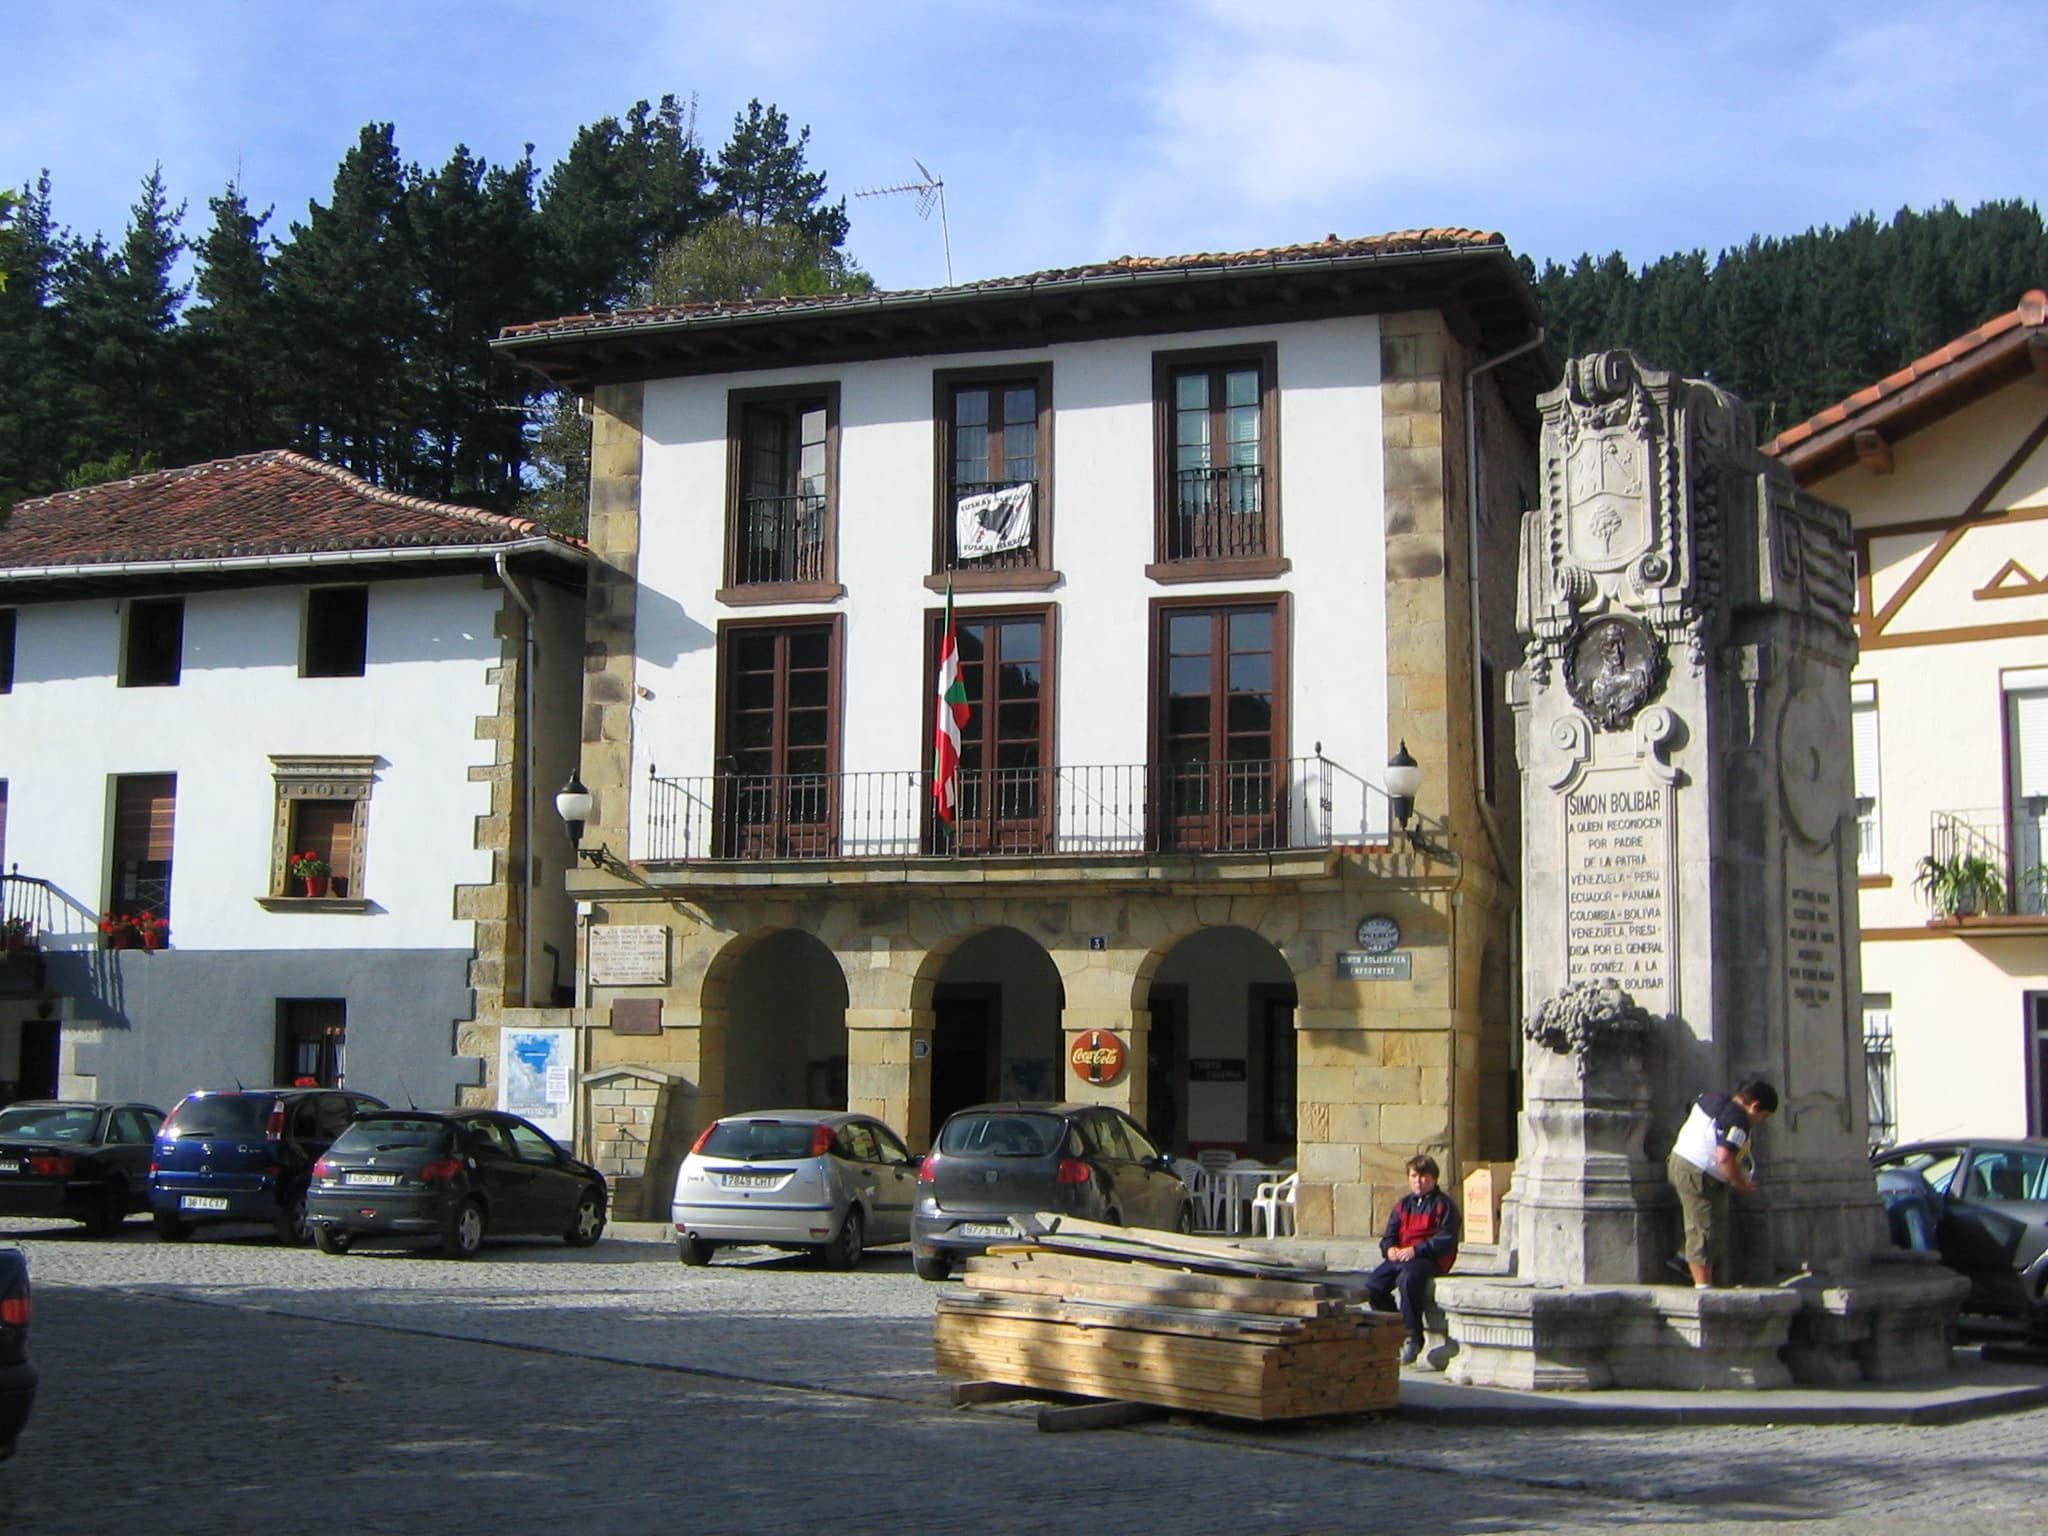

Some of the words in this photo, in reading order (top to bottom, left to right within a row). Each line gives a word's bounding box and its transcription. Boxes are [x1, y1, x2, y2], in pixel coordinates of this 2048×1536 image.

[1569, 793, 1606, 816] SIMON
[1611, 790, 1661, 814] BOLIBAR
[1577, 821, 1603, 832] QUIEN
[1607, 818, 1662, 831] RECONOCEN
[1588, 838, 1607, 849] POR
[1614, 836, 1643, 848] PADRE
[1584, 857, 1595, 868] DE
[1600, 856, 1612, 867] LA
[1616, 854, 1647, 866] PATRIA
[1571, 873, 1624, 885] VENEZUELA
[1571, 891, 1612, 903] ECUADOR
[1622, 888, 1661, 900] PANAMA
[1570, 910, 1615, 921] COLOMBIA
[1624, 907, 1661, 920] BOLIVIA
[1569, 944, 1589, 956] DIDA
[1594, 943, 1611, 954] POR
[1614, 943, 1622, 954] EL
[1626, 942, 1664, 953] GENERAL
[1634, 960, 1640, 972] A
[1645, 959, 1657, 972] LA
[1624, 977, 1664, 989] BOLIBAR
[1072, 1047, 1119, 1065] Coca-Cola
